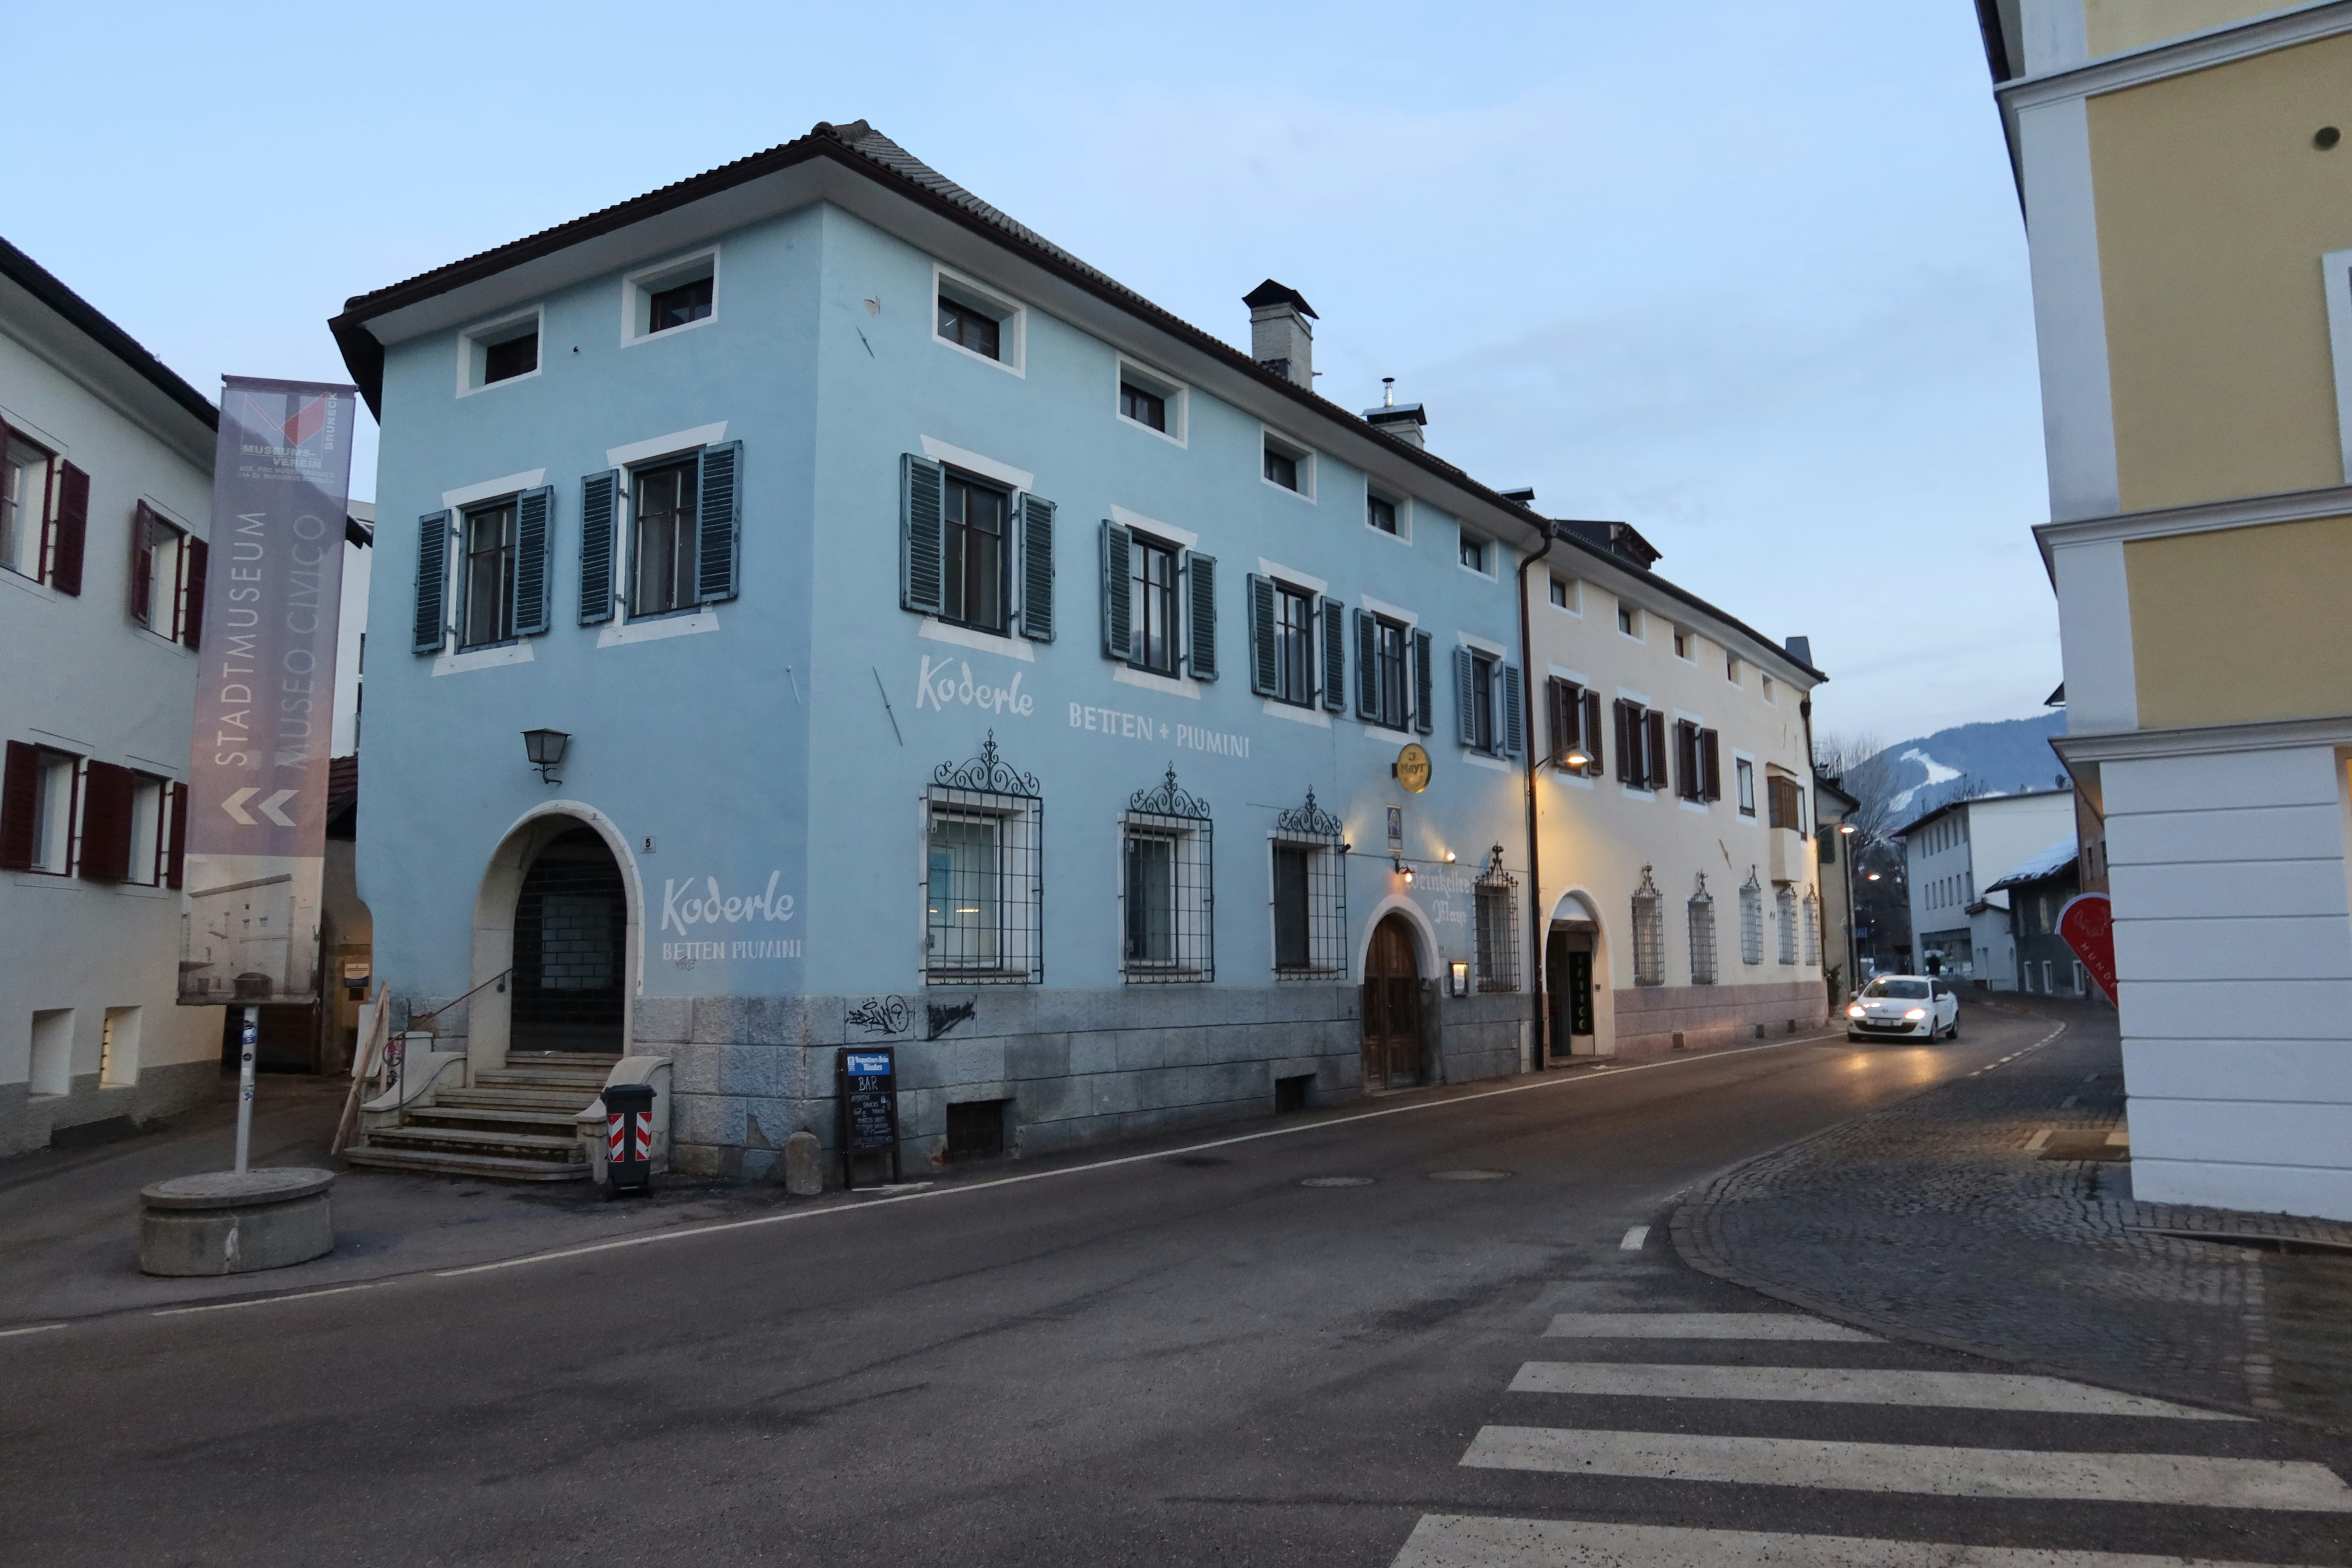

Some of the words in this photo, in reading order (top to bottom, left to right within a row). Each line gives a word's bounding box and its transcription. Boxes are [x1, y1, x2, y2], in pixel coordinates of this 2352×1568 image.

[325, 392, 337, 450] BRUNECK
[243, 444, 316, 457] MUSEUMS-
[273, 458, 322, 469] VEREIN
[287, 514, 325, 634] CIVICO
[216, 512, 266, 766] STADTMUSEUM
[275, 650, 315, 769] MUSEO
[916, 654, 1034, 717] Koderle
[1069, 702, 1153, 741] BETTEN
[1176, 724, 1250, 758] PIUMINI
[646, 838, 651, 847] 5
[661, 870, 794, 936] Koderle
[662, 941, 726, 961] BETTEN
[732, 940, 801, 959] PIUMINI
[858, 1075, 878, 1091] BAR
